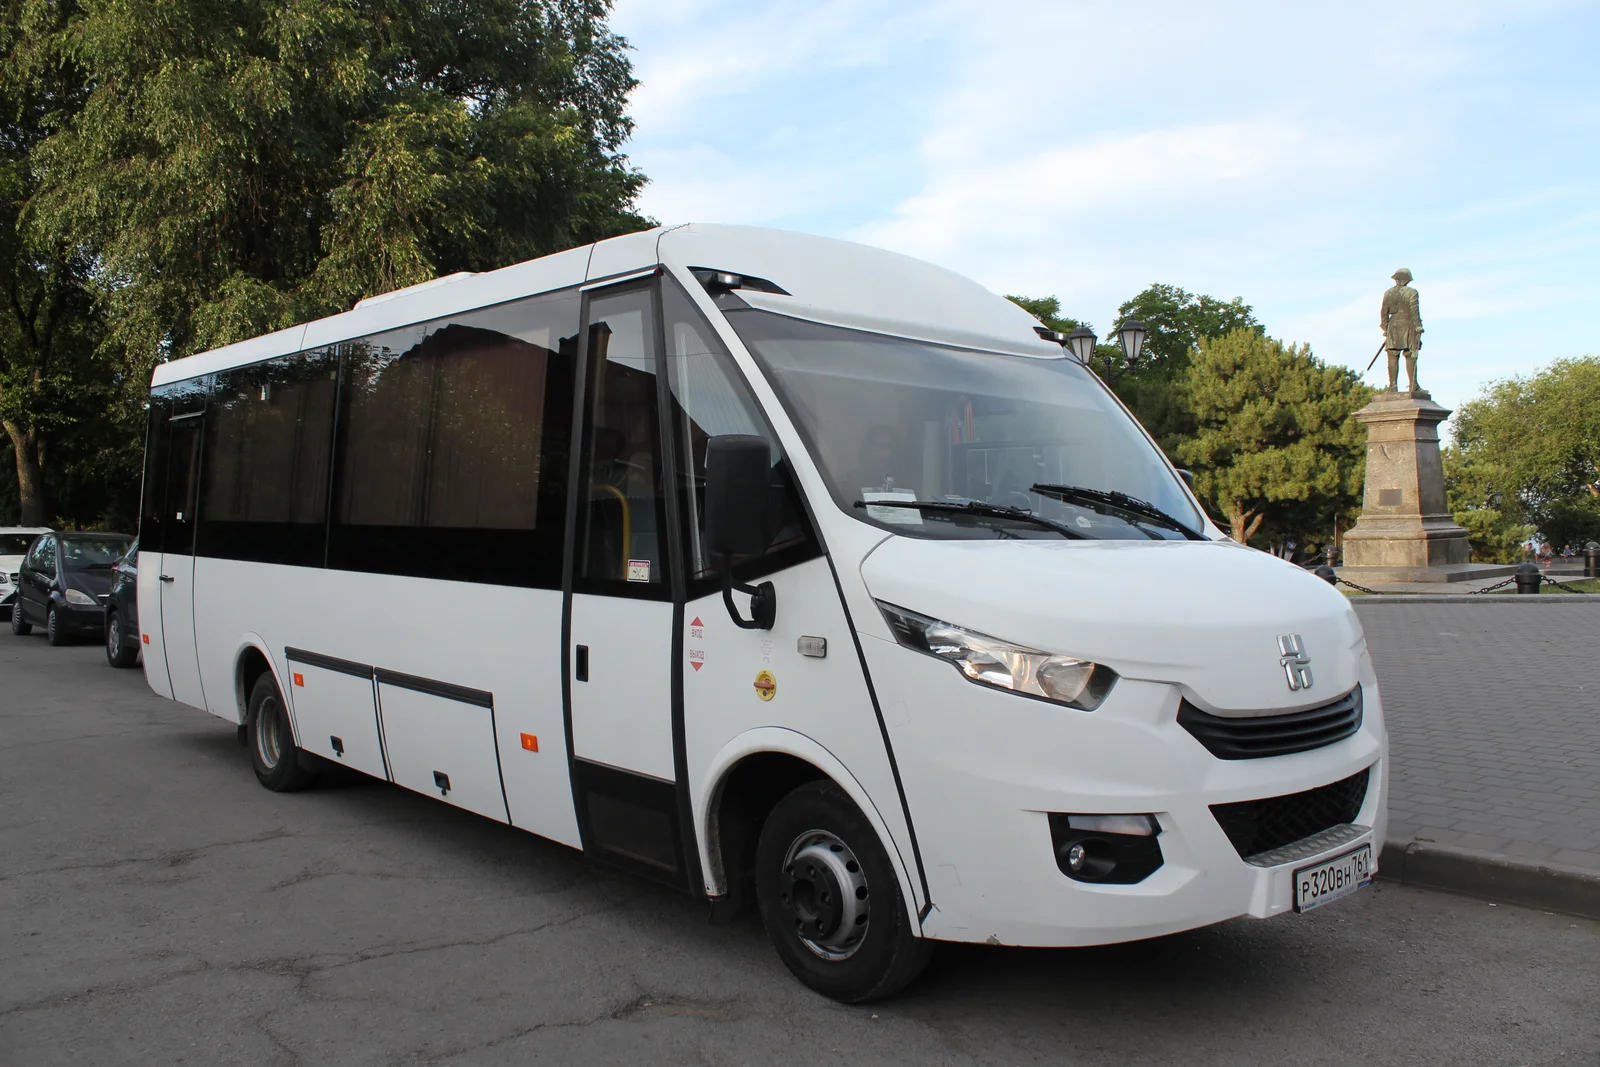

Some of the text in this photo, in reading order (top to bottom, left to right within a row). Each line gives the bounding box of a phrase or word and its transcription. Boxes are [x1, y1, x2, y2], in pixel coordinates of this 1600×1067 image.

[691, 629, 702, 638] ВХОД
[690, 649, 704, 660] ВЫХОД
[1352, 852, 1368, 875] 761
